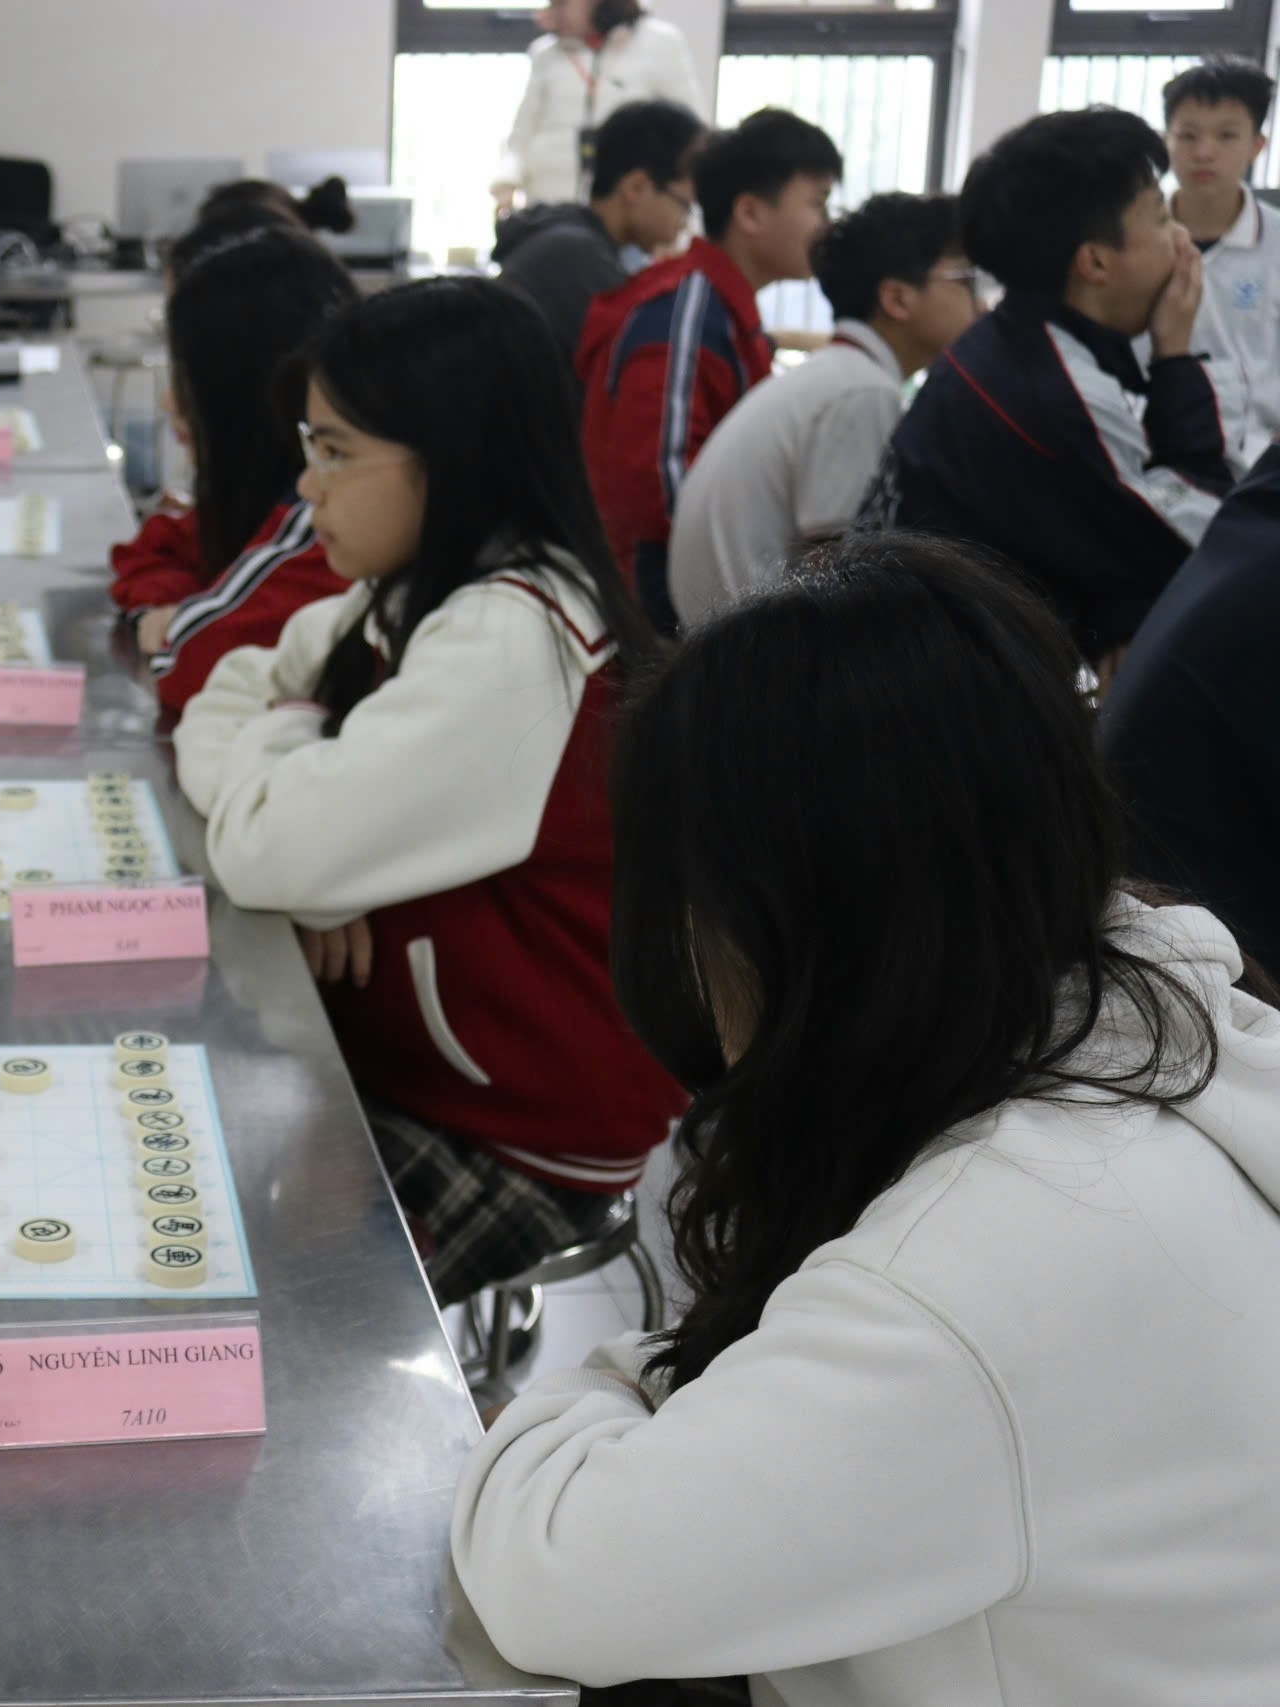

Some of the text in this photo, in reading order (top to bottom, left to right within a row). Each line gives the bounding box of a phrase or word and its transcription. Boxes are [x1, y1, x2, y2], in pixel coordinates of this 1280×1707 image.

[127, 1347, 179, 1366] LINH
[184, 1343, 254, 1363] GIANG
[121, 1408, 167, 1426] 7A10
